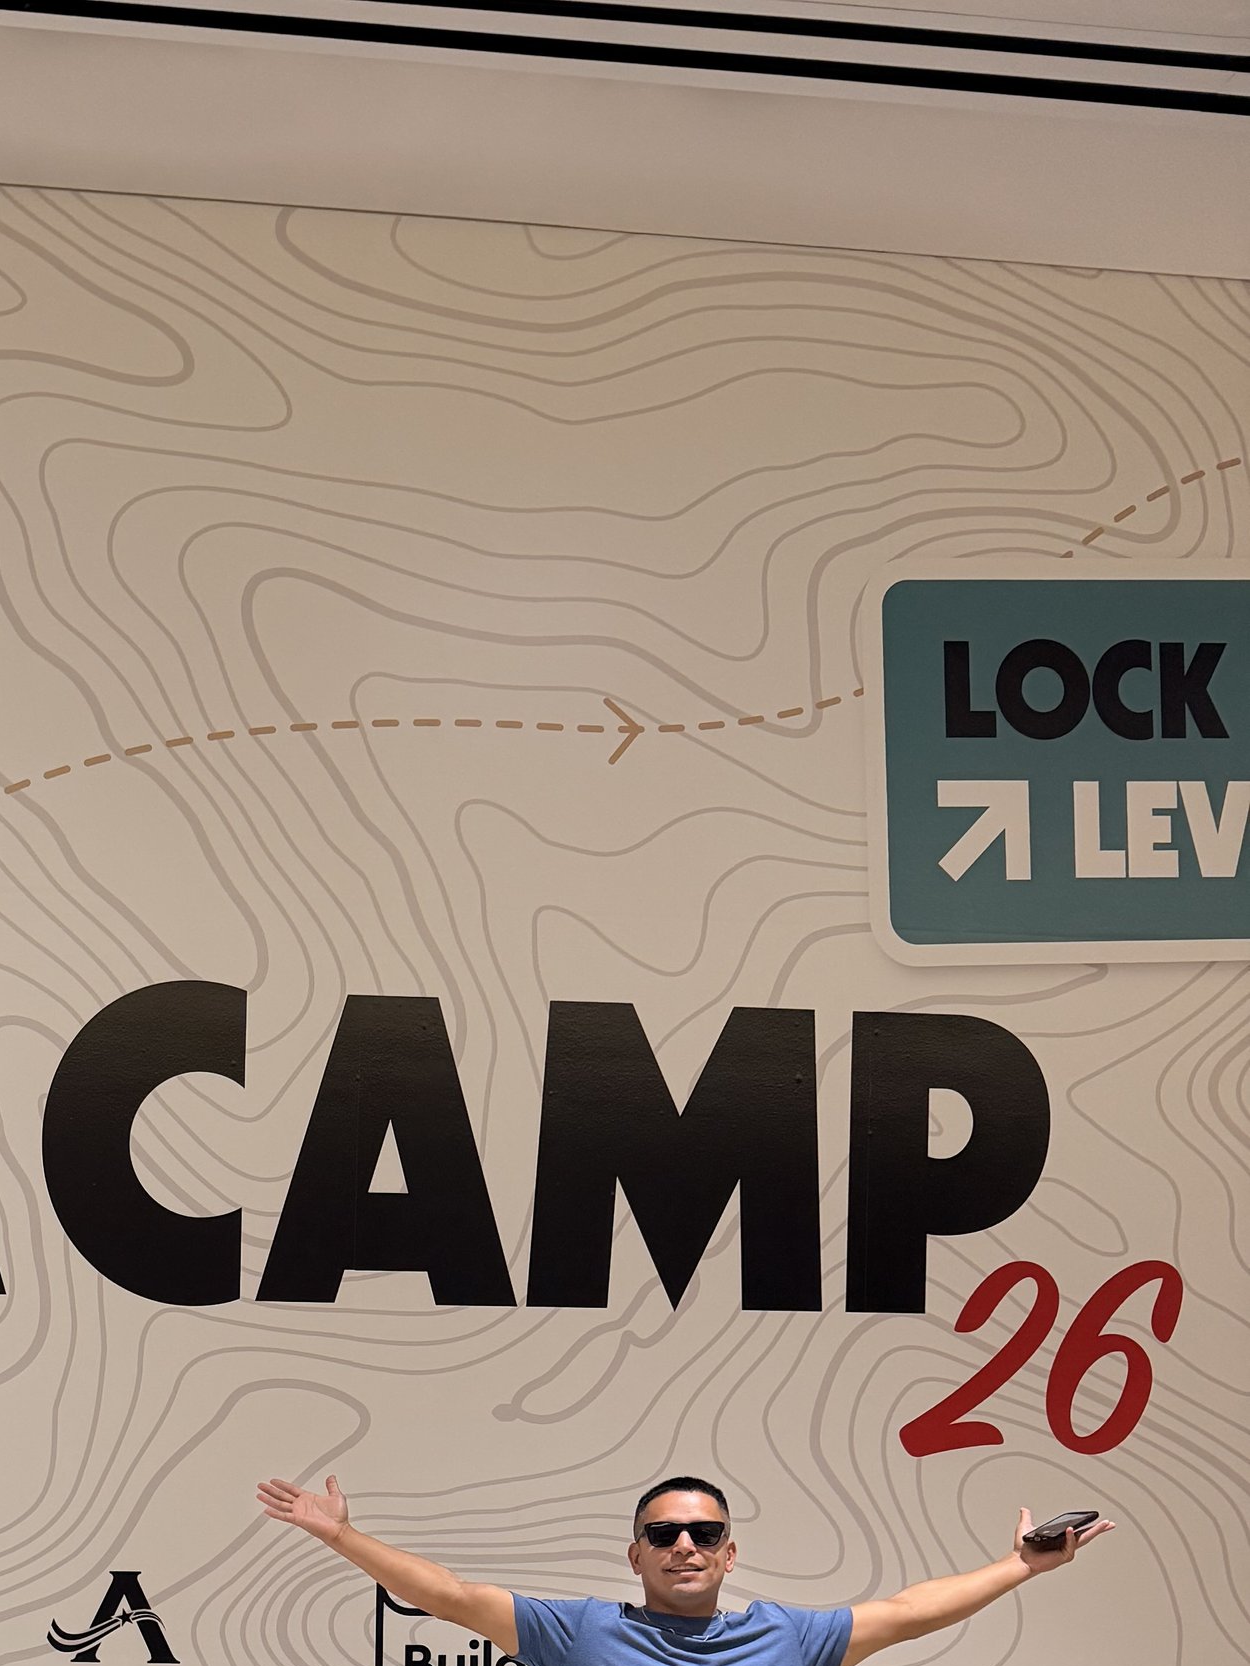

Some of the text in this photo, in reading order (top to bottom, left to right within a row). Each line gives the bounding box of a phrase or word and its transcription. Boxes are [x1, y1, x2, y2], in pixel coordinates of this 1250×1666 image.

[943, 638, 1230, 740] LOCK
[1072, 780, 1250, 879] LEV
[42, 979, 1051, 1314] CAMP
[899, 1260, 1183, 1457] 26
